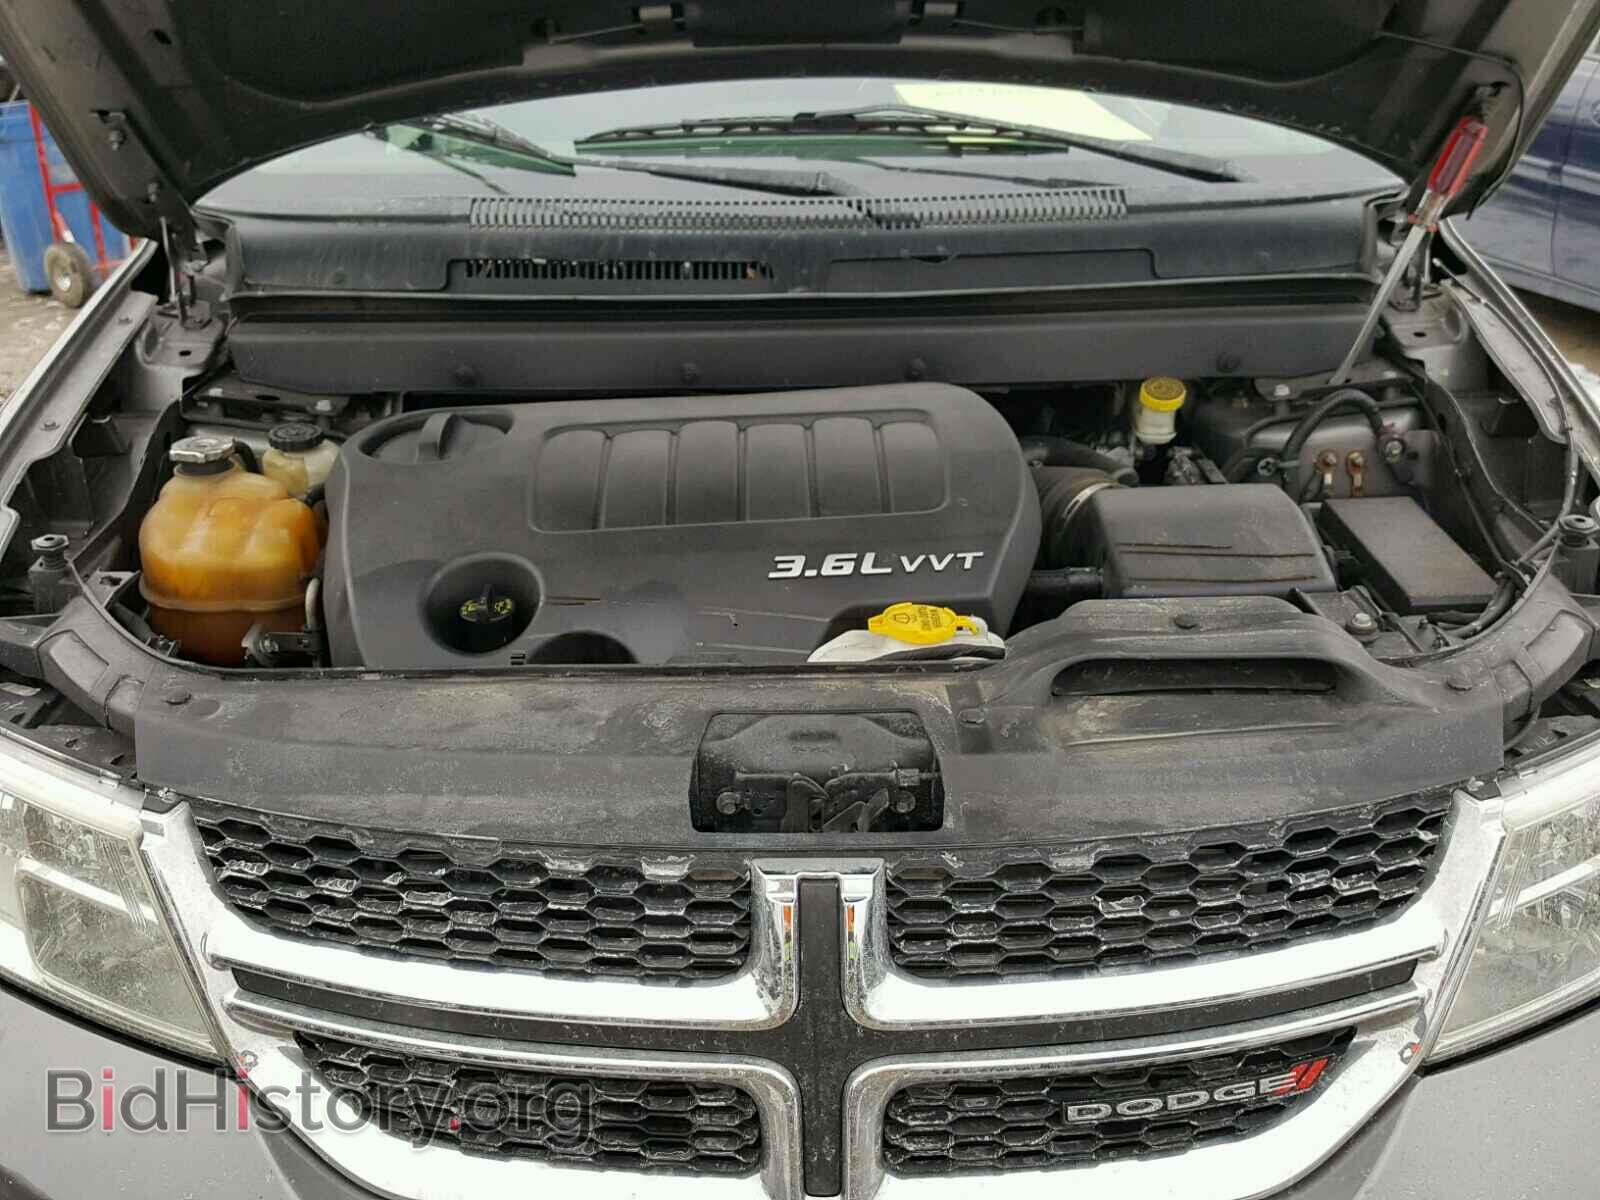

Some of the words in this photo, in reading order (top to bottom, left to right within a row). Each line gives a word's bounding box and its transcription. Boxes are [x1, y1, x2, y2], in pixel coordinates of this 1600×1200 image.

[768, 552, 892, 578] 3.6L
[900, 552, 984, 573] VVT
[1067, 1071, 1298, 1122] DODGE
